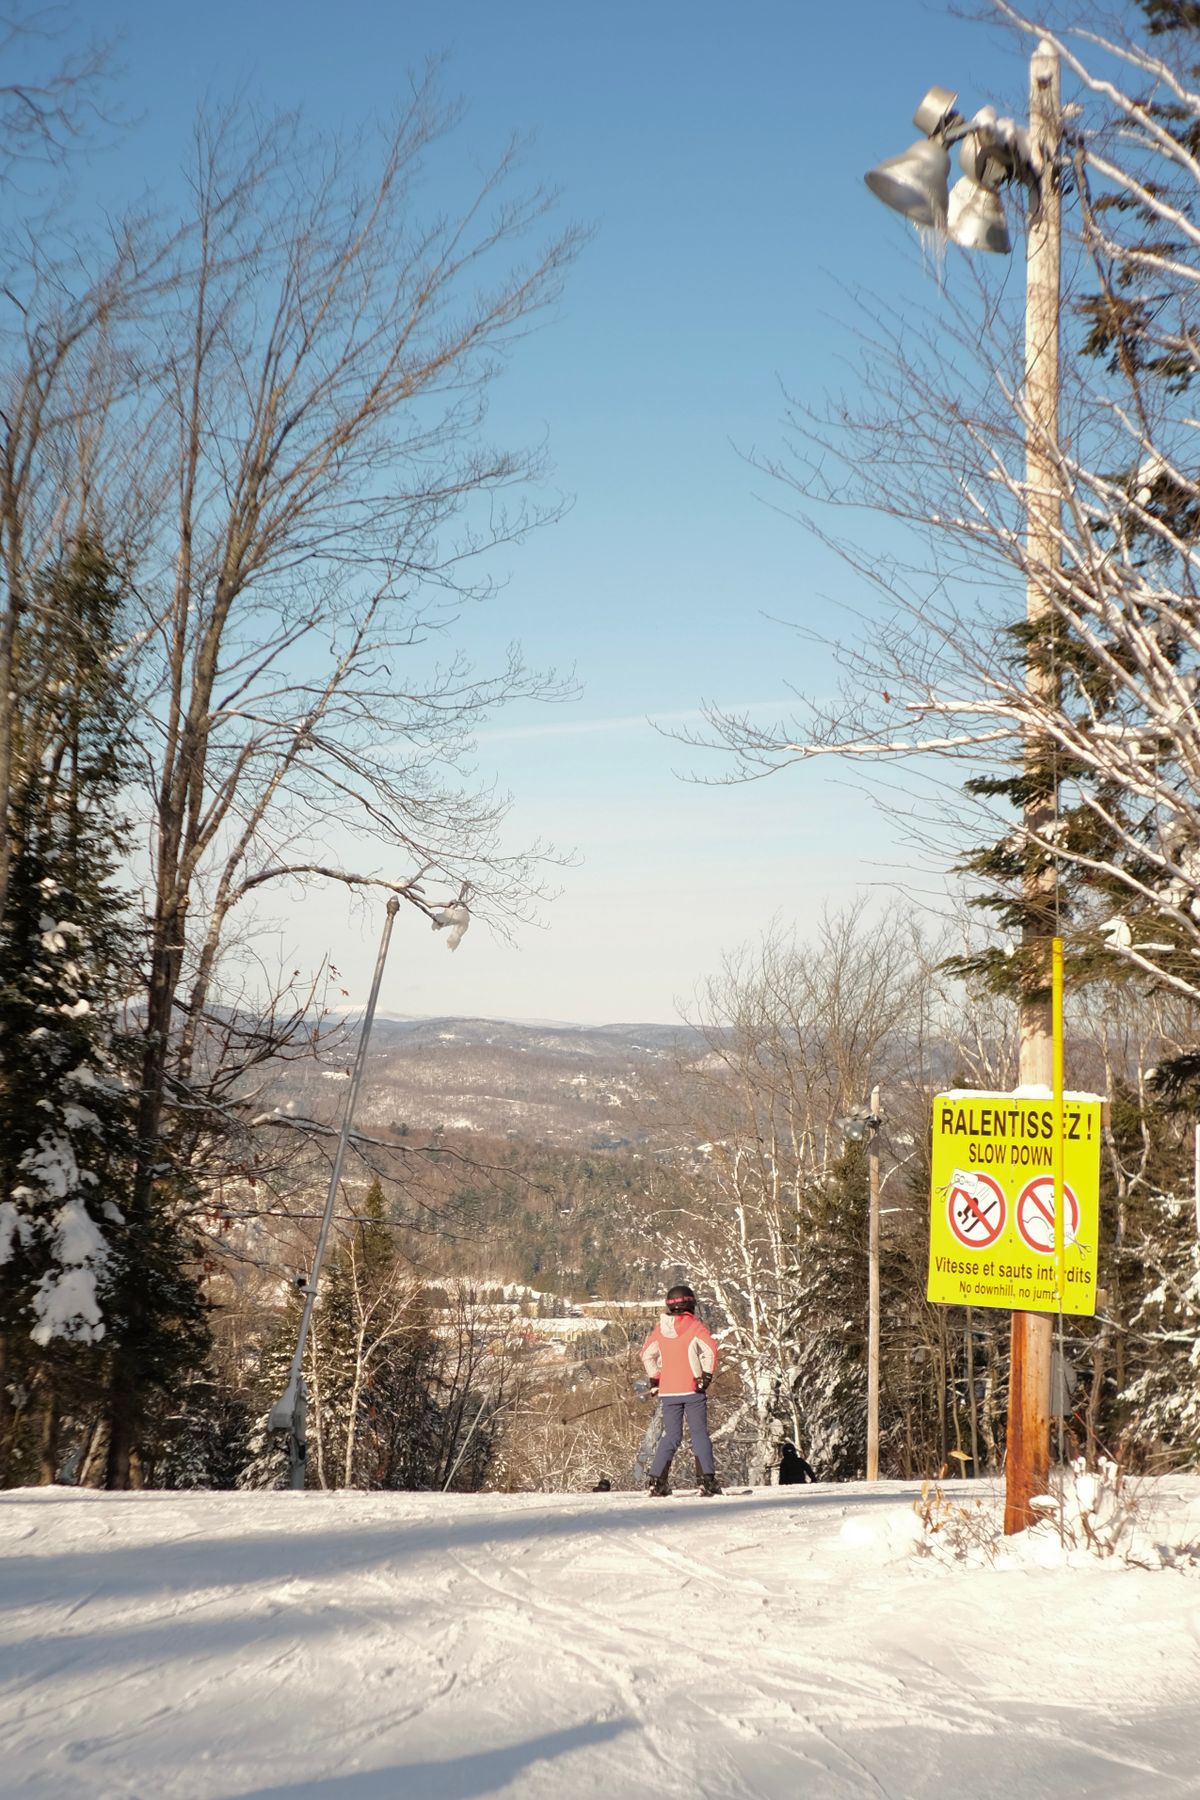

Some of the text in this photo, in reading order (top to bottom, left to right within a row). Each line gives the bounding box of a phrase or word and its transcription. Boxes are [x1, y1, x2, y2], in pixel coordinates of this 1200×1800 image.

[969, 1142, 1053, 1167] SLOW DOWN
[935, 1256, 1092, 1284] Vitesse et sauts intdits
[959, 1280, 972, 1293] No
[974, 1282, 1016, 1298] downhill,
[1018, 1288, 1031, 1298] no
